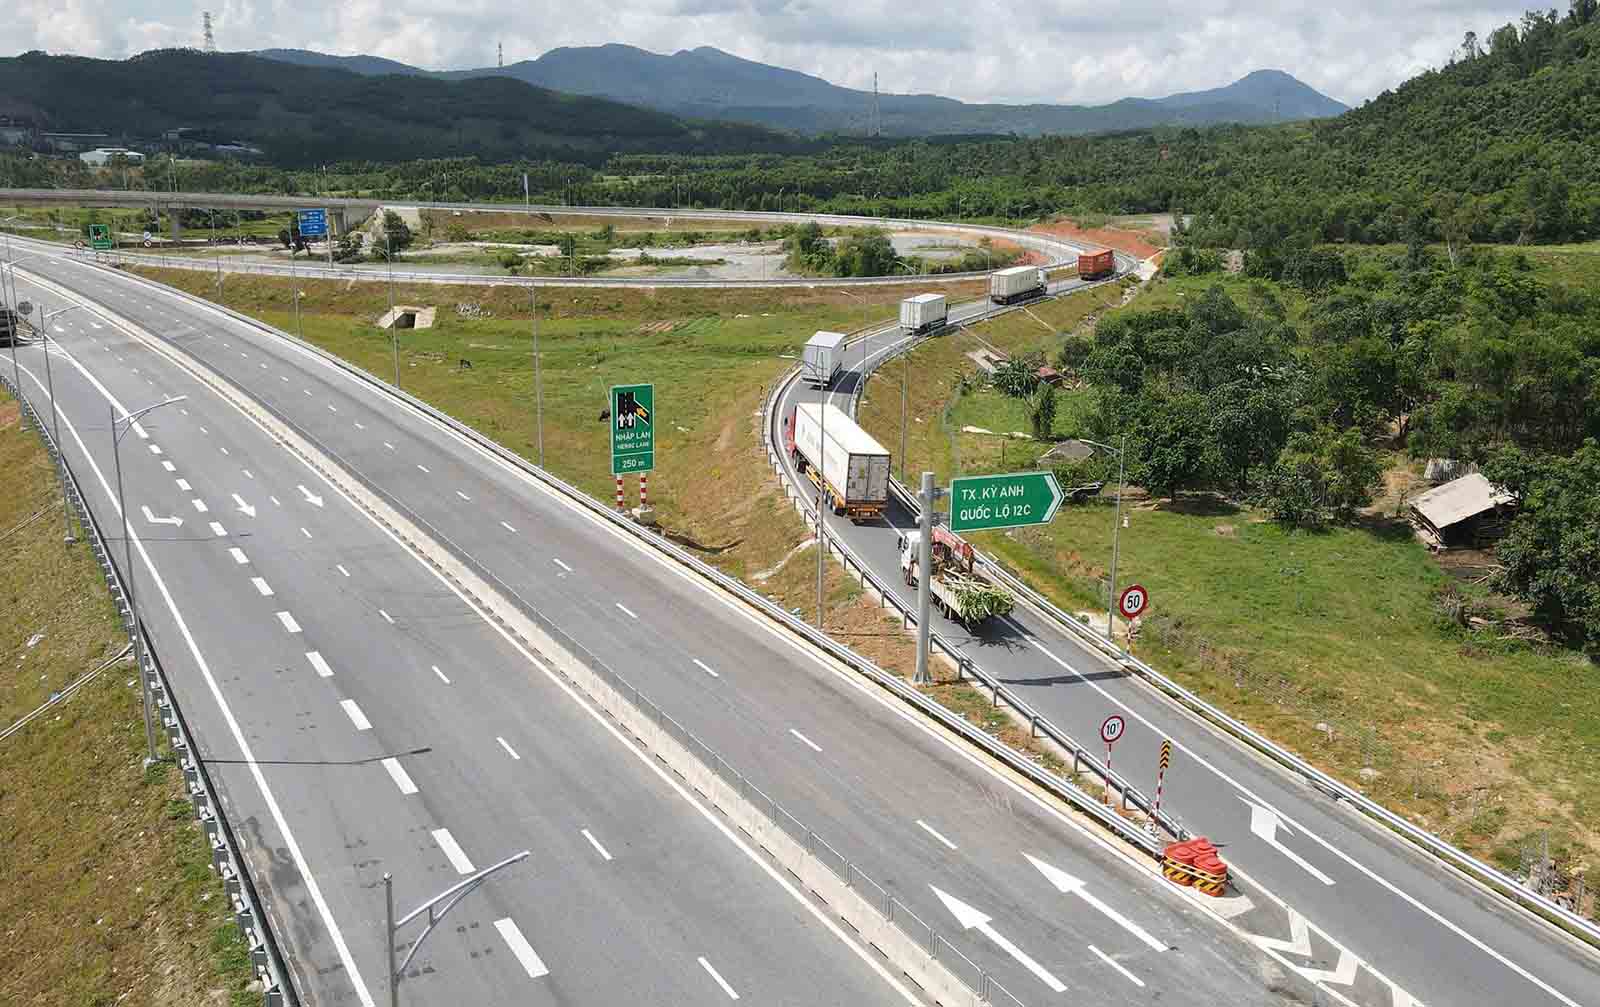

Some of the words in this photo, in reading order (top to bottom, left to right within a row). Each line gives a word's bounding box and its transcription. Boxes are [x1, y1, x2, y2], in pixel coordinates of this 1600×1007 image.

[623, 459, 637, 469] 250
[982, 484, 998, 499] KỲ
[1000, 485, 1024, 498] ANH
[960, 504, 991, 520] QUỐC
[995, 505, 1010, 519] LỘ
[1013, 504, 1031, 516] 12C
[1127, 594, 1140, 609] 50
